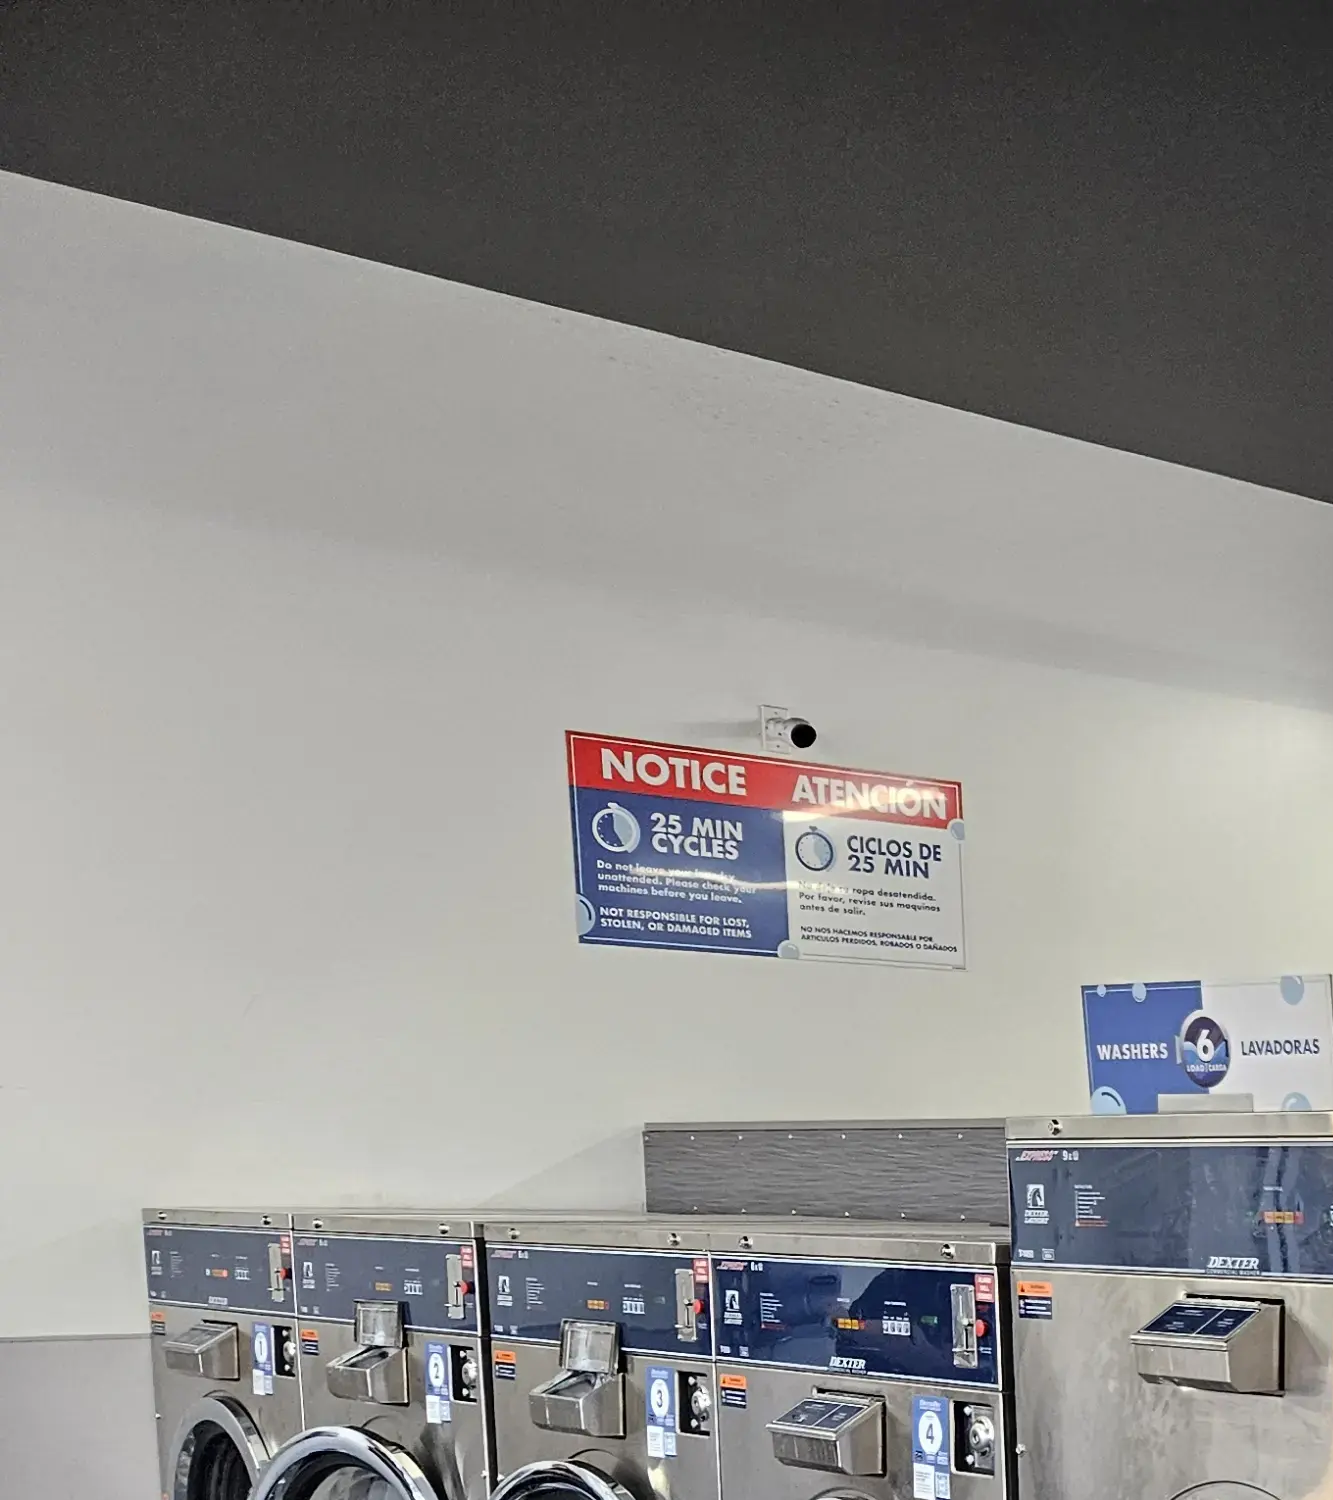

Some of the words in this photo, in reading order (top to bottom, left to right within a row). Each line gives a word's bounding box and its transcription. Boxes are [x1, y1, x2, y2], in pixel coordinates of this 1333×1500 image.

[600, 748, 748, 796] NOTICE
[791, 774, 948, 820] ATENCIÓN
[650, 812, 682, 834] 25
[691, 817, 743, 841] MIN
[651, 834, 740, 861] CYCLES
[846, 835, 913, 859] CICLOS
[918, 842, 942, 861] DE
[596, 859, 612, 870] Do
[615, 862, 633, 872] not
[847, 854, 875, 873] 25
[883, 858, 929, 879] MIN
[597, 873, 663, 886] unattended.
[665, 877, 699, 889] Please
[701, 880, 731, 892] check
[598, 884, 648, 896] machines
[651, 886, 686, 899] before
[689, 892, 708, 902] you
[711, 893, 743, 904] leave.
[799, 892, 815, 901] Por
[818, 893, 846, 905] favor,
[849, 897, 877, 907] revise
[879, 899, 895, 908] sus
[852, 888, 875, 897] ropa
[877, 888, 937, 902] desatendida.
[600, 906, 624, 917] NOT
[626, 908, 696, 924] RESPONSIBLE
[699, 915, 720, 926] FOR
[722, 917, 750, 929] LOST,
[799, 904, 825, 912] antes
[828, 904, 840, 914] de
[843, 906, 867, 917] salir.
[600, 918, 645, 931] STOLEN,
[647, 922, 664, 932] OR
[667, 923, 720, 937] DAMAGED
[722, 927, 752, 939] ITEMS
[814, 926, 831, 934] NOS
[832, 928, 868, 938] HACEMOS
[918, 935, 934, 943] POR
[880, 940, 914, 949] ROBADOS
[1096, 1042, 1169, 1061] WASHERS
[1196, 1029, 1215, 1062] 6
[1240, 1038, 1321, 1056] LAVADORAS
[1207, 1256, 1260, 1270] DEXTER
[433, 1362, 440, 1378] 2
[829, 1356, 866, 1370] DEXTER
[655, 1389, 664, 1409] 3
[926, 1423, 935, 1444] 4
